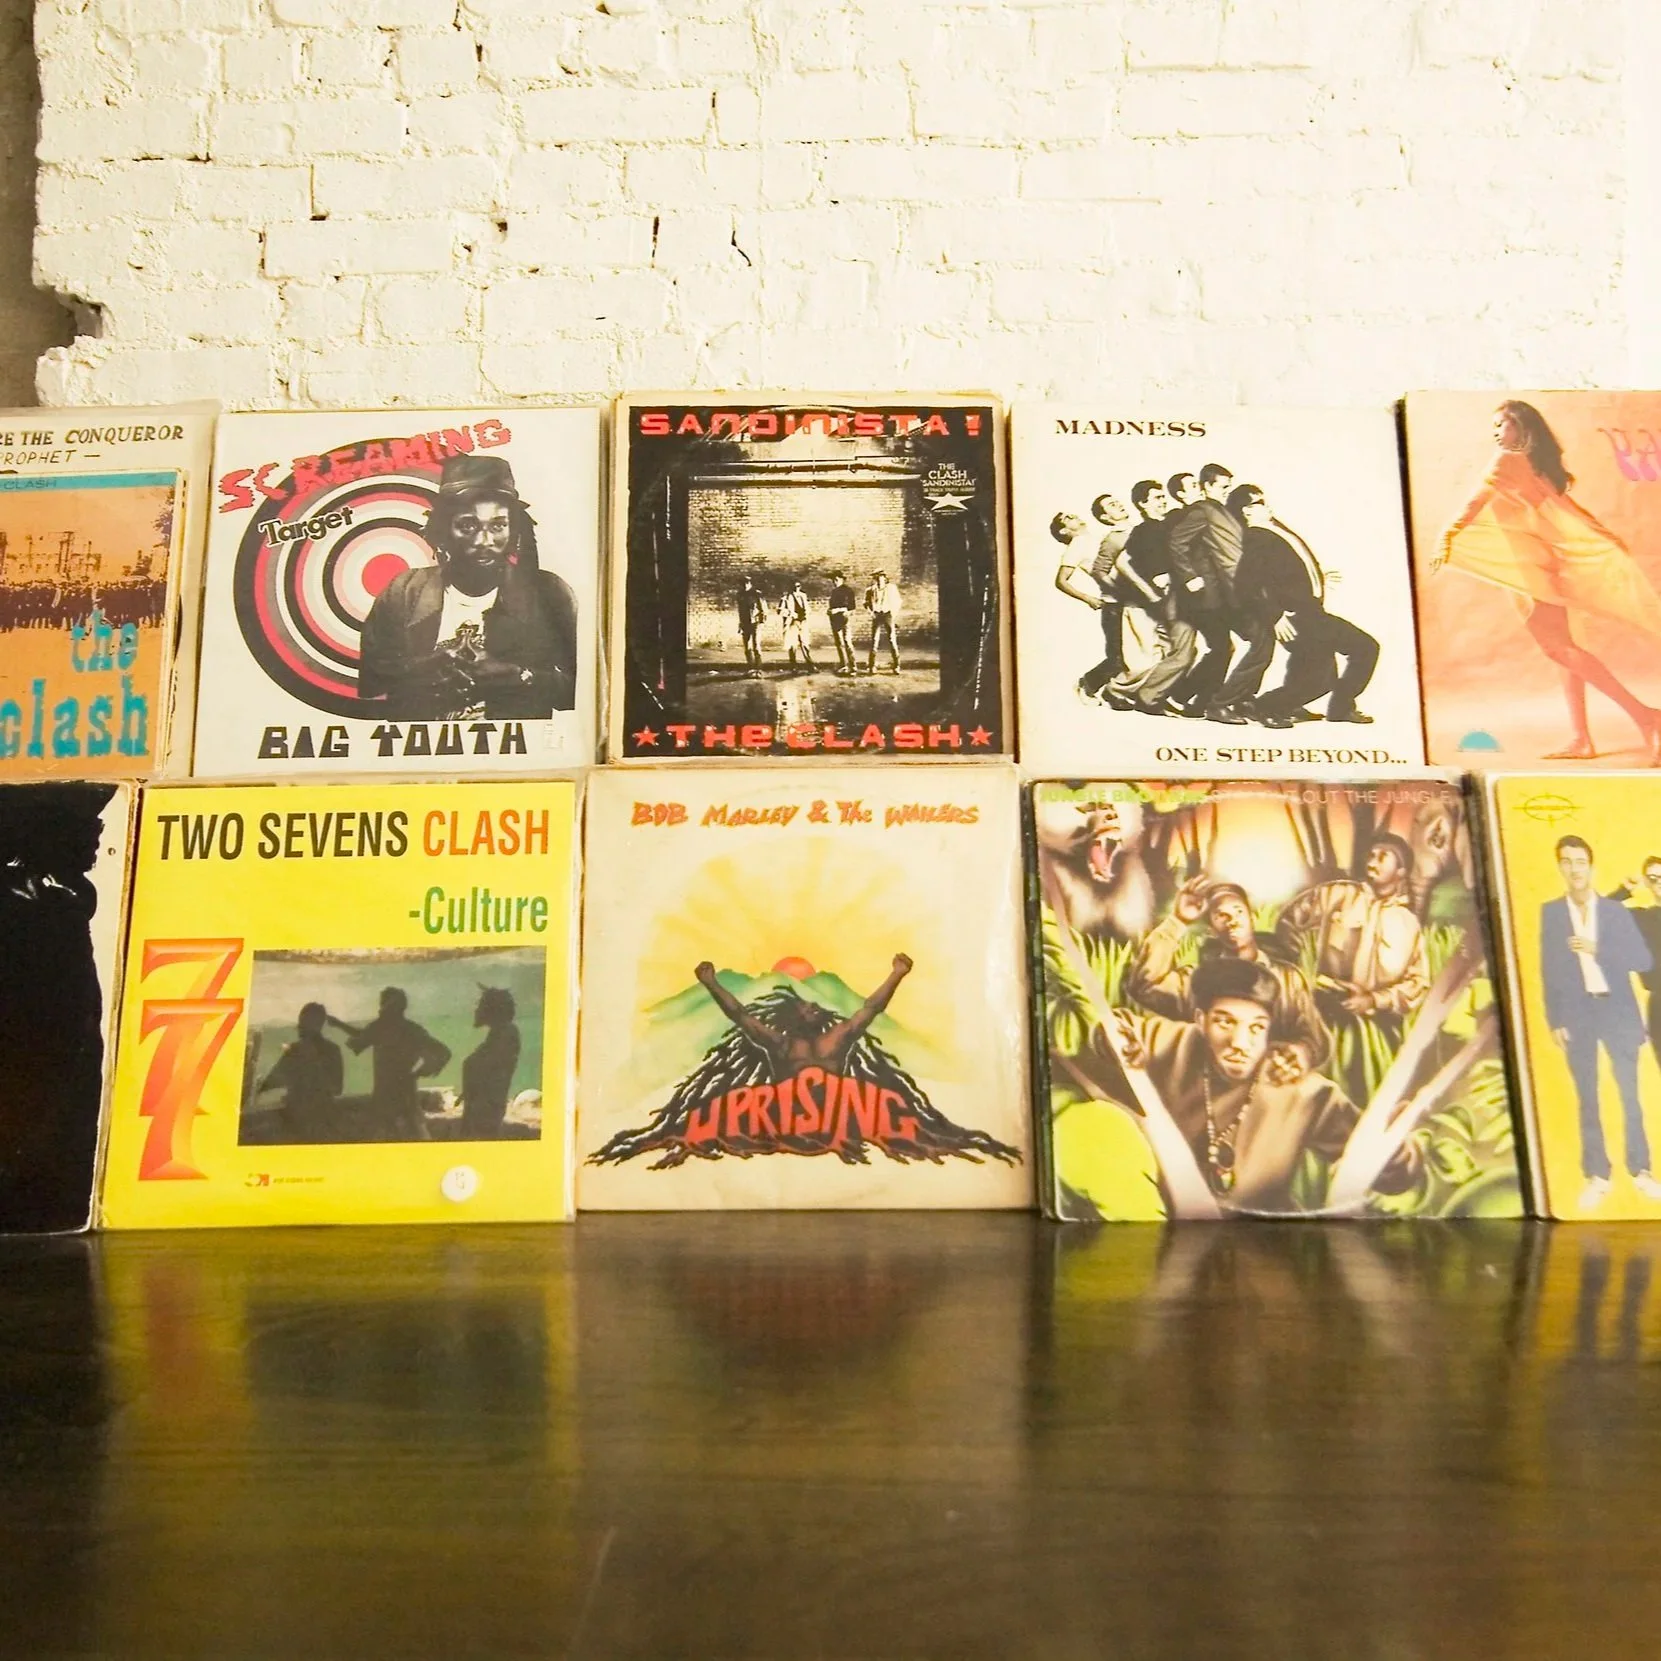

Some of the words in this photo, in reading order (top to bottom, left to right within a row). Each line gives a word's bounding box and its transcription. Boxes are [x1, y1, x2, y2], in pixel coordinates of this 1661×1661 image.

[20, 430, 54, 446] THE
[65, 425, 184, 445] CONQUEROR
[1055, 419, 1207, 438] MADNESS
[218, 418, 512, 514] SCREAMING
[928, 470, 967, 479] CLASH
[3, 479, 57, 490] CLASH
[259, 506, 354, 547] Target
[71, 608, 139, 672] the
[0, 675, 149, 758] clash
[257, 725, 351, 759] BIG
[370, 722, 528, 758] YOUTH
[666, 723, 774, 748] THE
[786, 723, 961, 749] CLASH
[1155, 747, 1207, 763] ONE
[1215, 746, 1282, 763] STEP
[1302, 790, 1339, 804] OUT
[1346, 790, 1378, 804] THE
[1385, 790, 1452, 804] JUNGLE
[631, 801, 689, 827] BOB
[807, 800, 832, 824] &
[157, 812, 244, 860] TWO
[257, 811, 409, 858] SEVENS
[423, 809, 550, 856] CLASH
[684, 1065, 918, 1148] UPRISING
